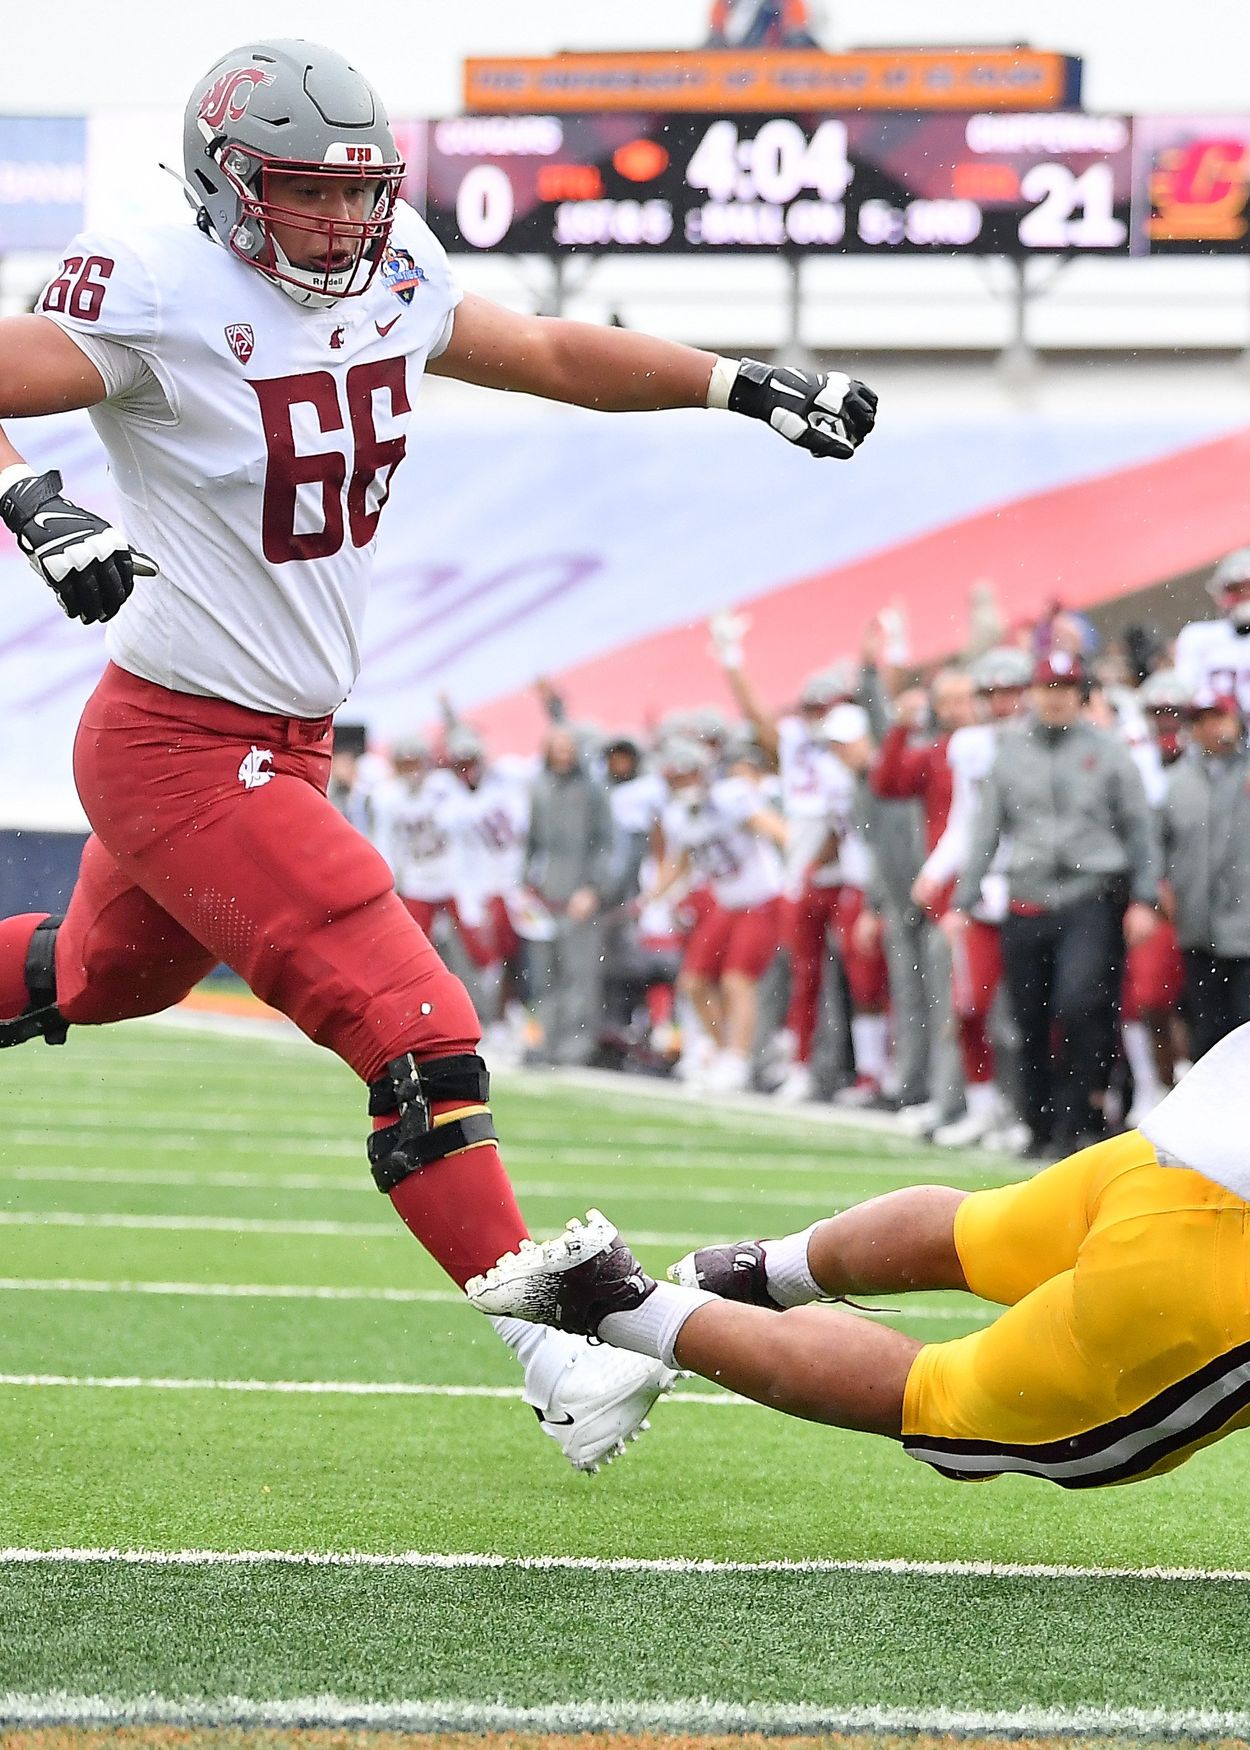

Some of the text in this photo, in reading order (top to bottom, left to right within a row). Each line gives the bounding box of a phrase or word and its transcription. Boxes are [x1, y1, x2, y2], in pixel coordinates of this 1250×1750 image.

[346, 147, 372, 162] WSU
[686, 119, 854, 204] 4:04
[456, 165, 514, 248] 0
[1018, 162, 1128, 247] 21
[42, 255, 116, 322] 66
[312, 277, 343, 286] Ridell
[225, 325, 253, 349] PAC
[235, 340, 251, 356] 12
[245, 356, 412, 565] 66
